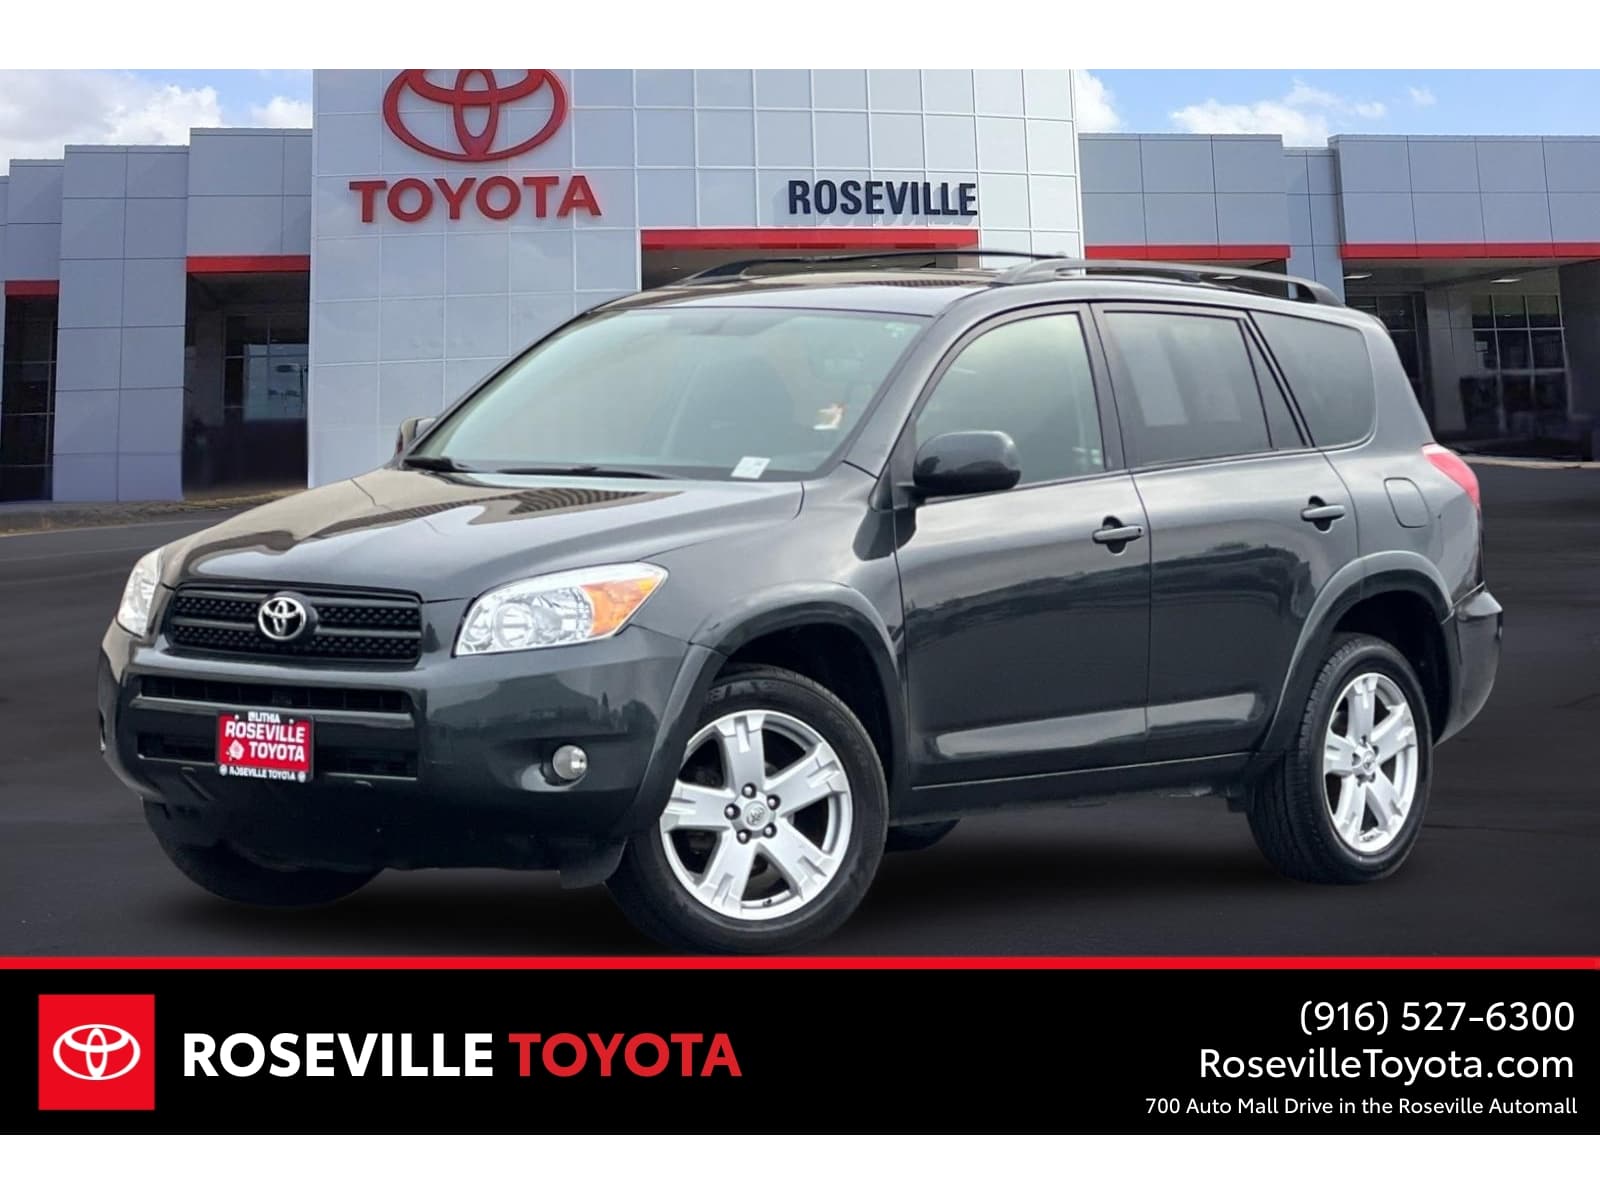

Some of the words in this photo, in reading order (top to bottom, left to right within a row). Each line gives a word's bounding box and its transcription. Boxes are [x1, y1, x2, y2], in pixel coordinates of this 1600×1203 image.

[349, 175, 602, 223] TOYOTA
[788, 179, 979, 217] ROSEVILLE
[225, 721, 305, 743] ROSEVILLE
[249, 741, 305, 762] TOYOTA
